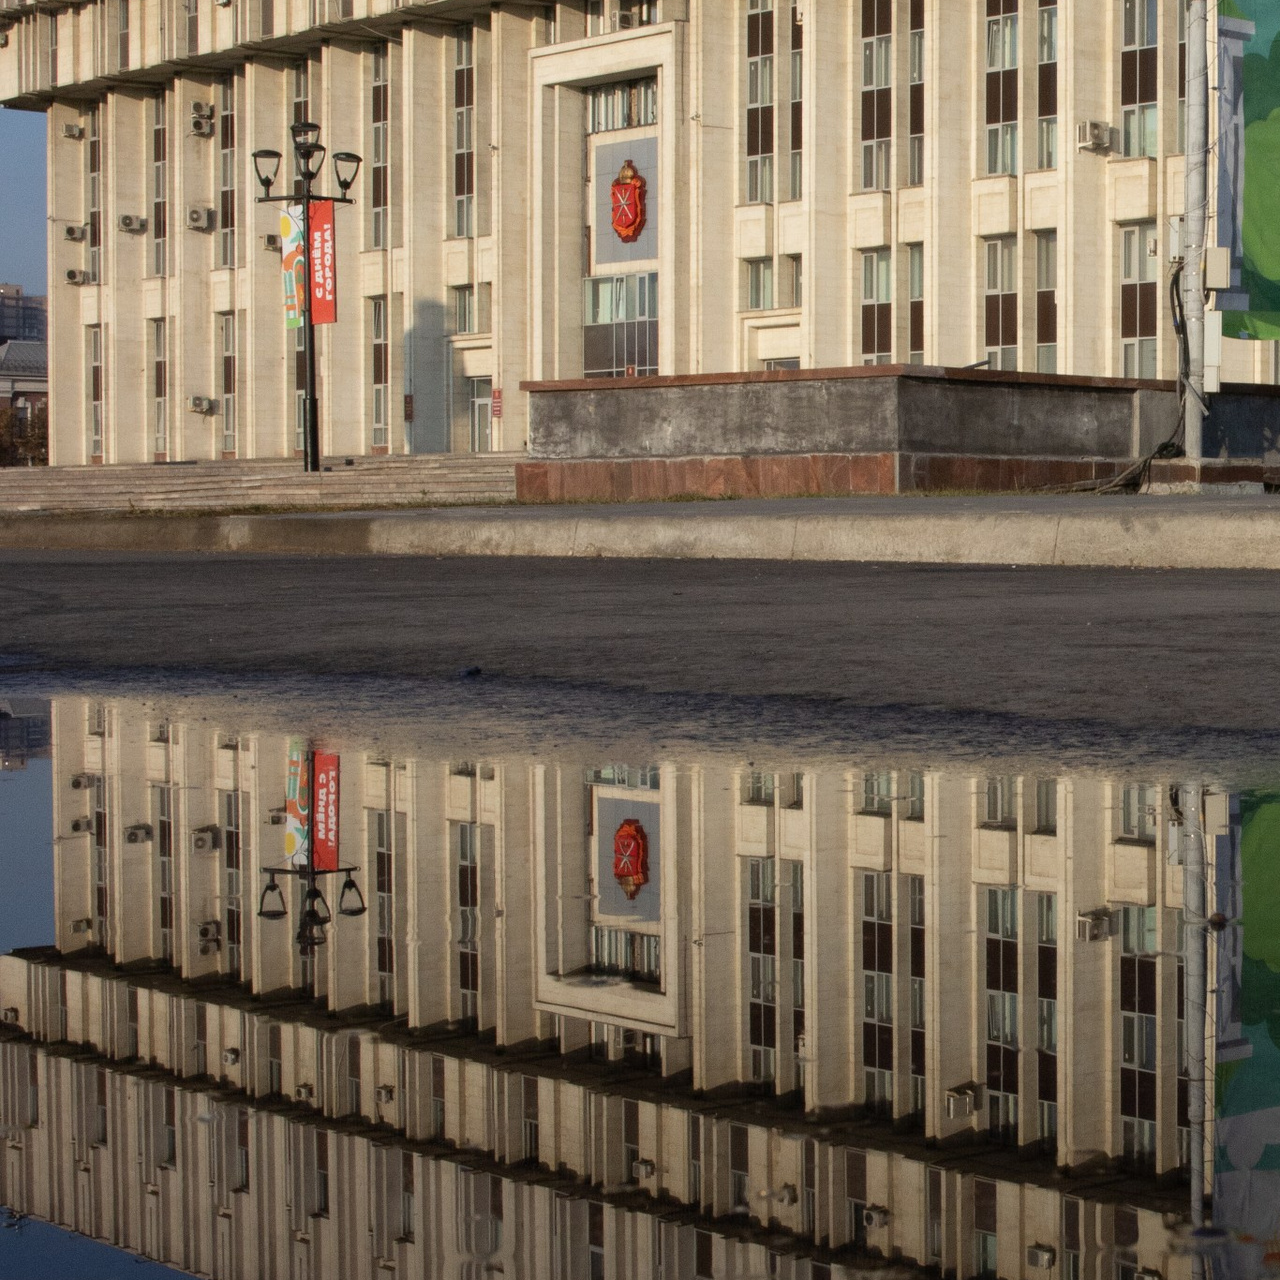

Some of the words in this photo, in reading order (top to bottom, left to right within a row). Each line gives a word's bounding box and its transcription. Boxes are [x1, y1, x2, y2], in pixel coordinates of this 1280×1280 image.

[312, 231, 323, 283] ДНЁМ
[323, 224, 332, 301] ГОРОДА!
[315, 287, 323, 299] С
